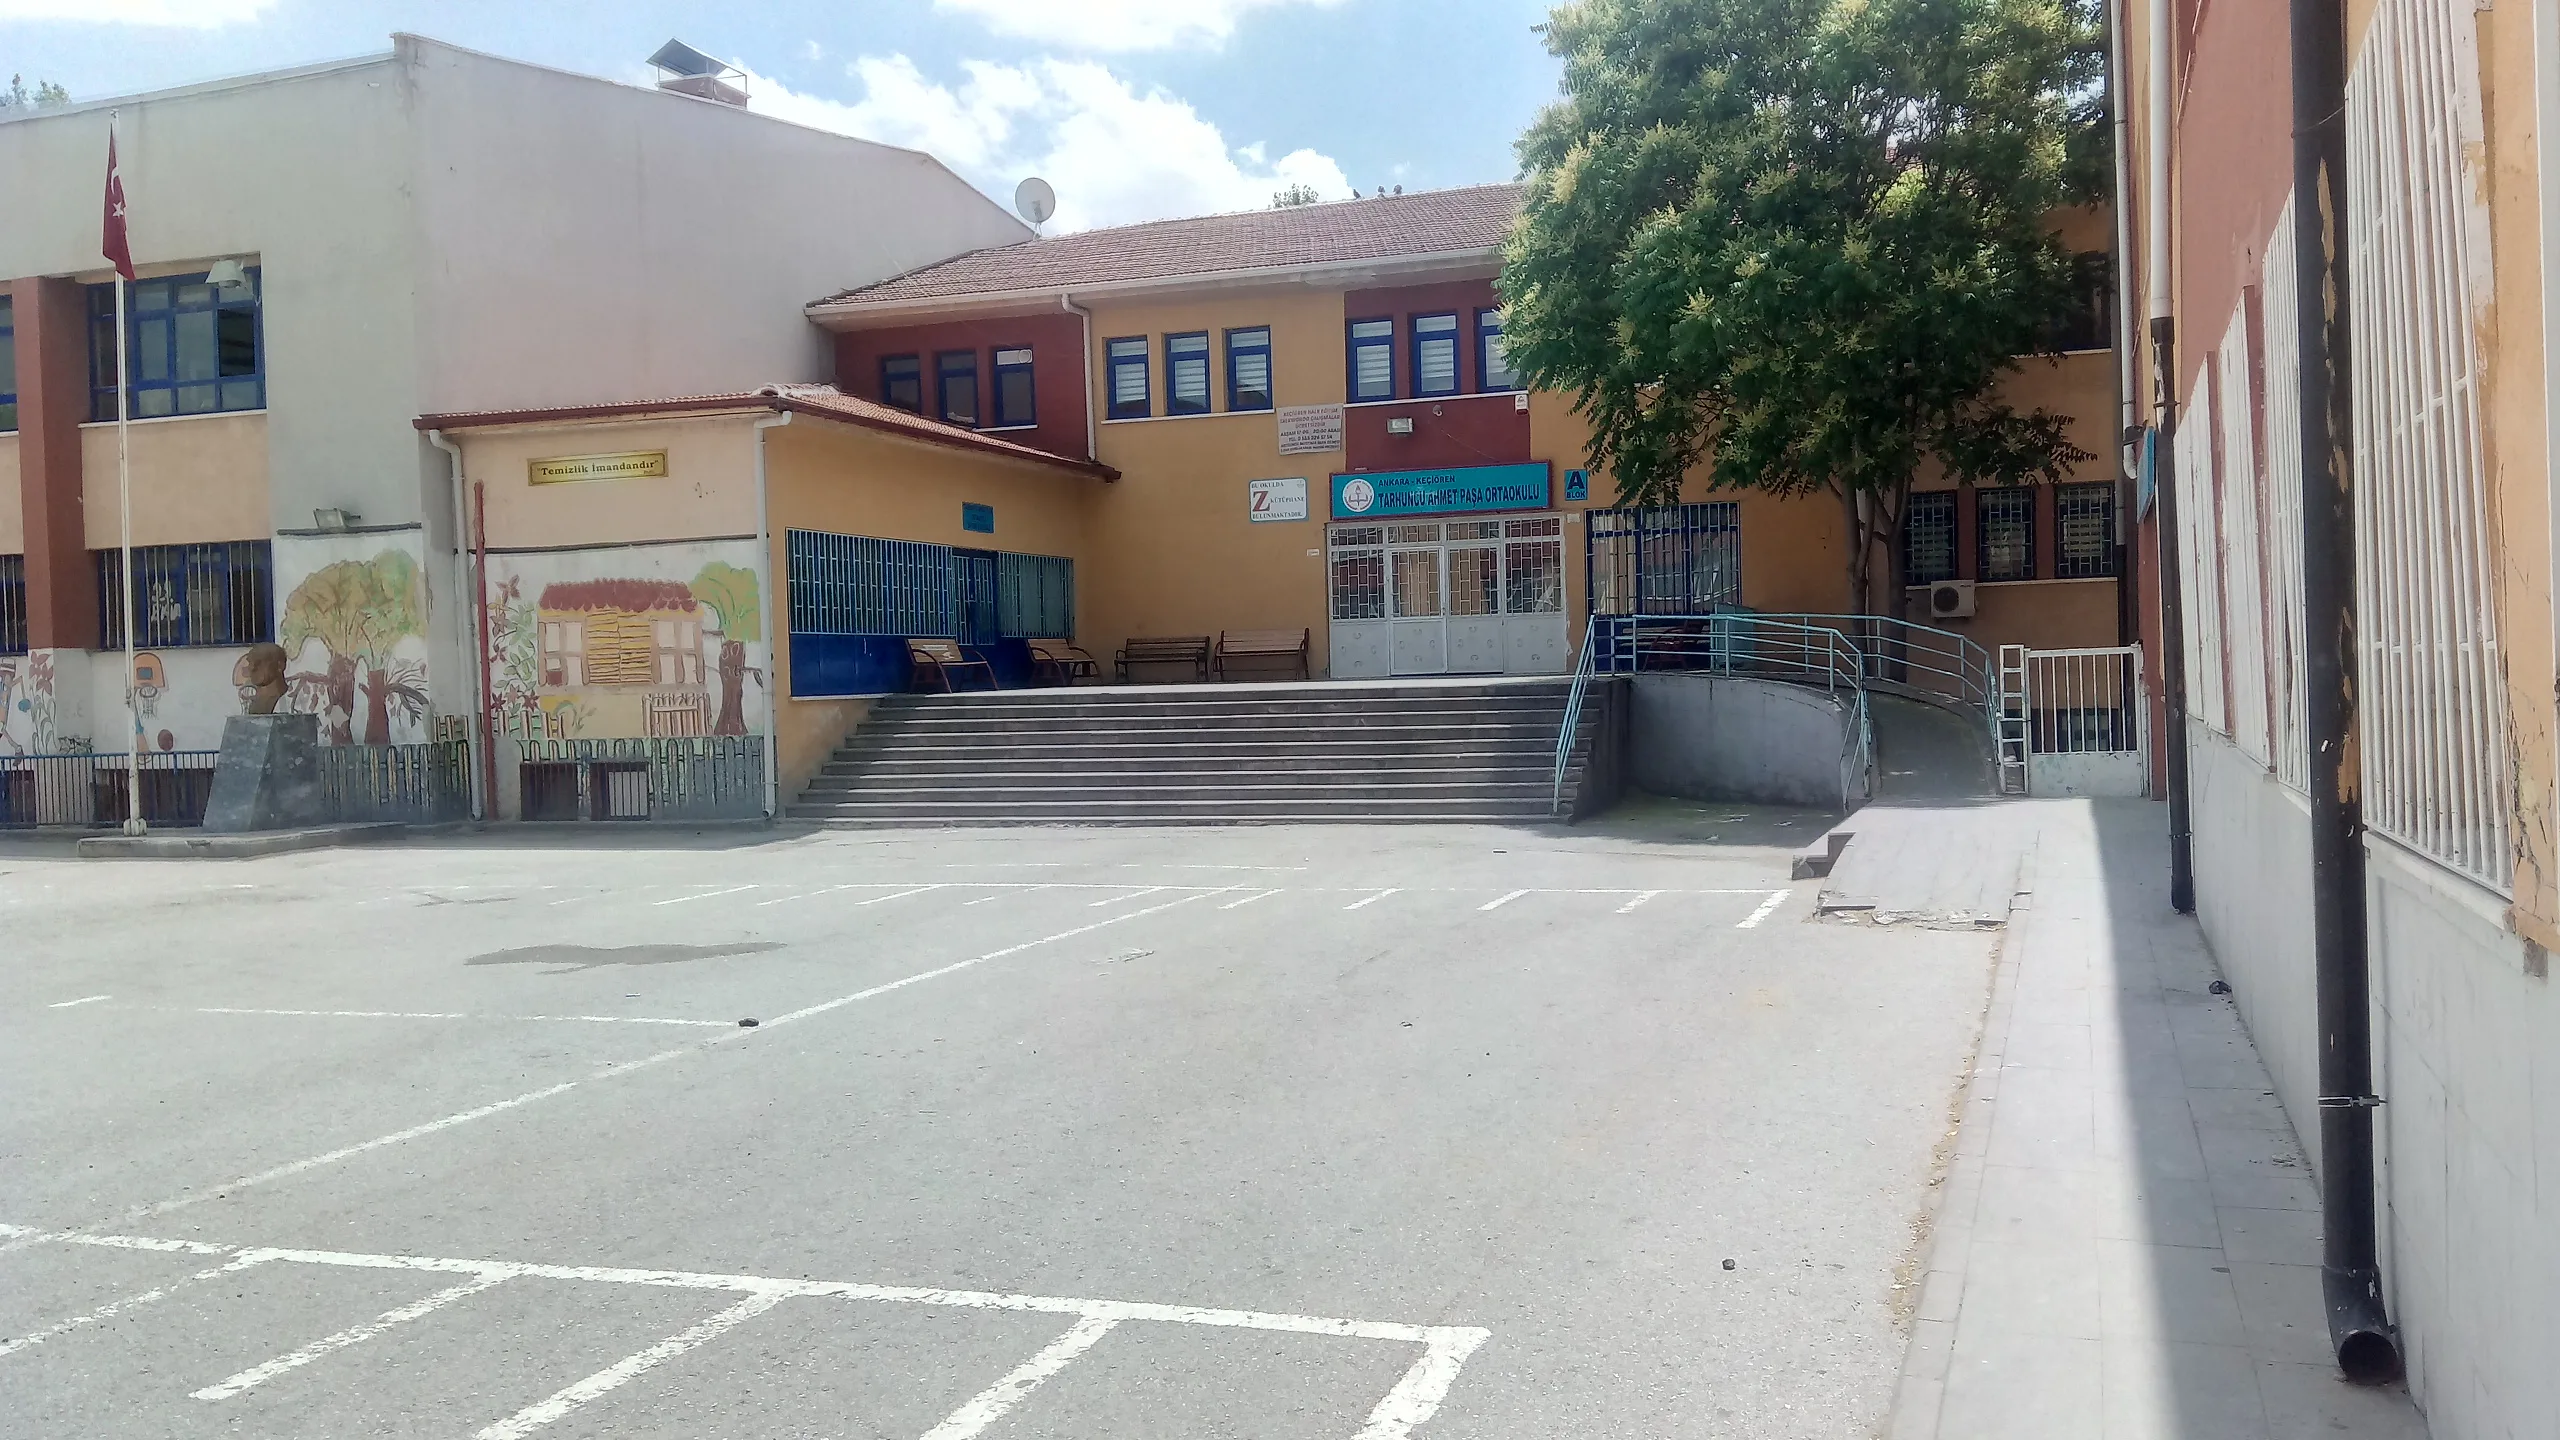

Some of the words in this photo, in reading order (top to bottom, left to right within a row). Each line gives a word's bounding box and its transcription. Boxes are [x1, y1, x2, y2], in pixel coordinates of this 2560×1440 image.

[1379, 477, 1410, 488] ANKARA
[1416, 474, 1456, 486] KEÇİÖREN
[1567, 471, 1585, 489] A
[1252, 491, 1271, 512] Z
[1379, 490, 1426, 508] TARHUNCU
[1427, 487, 1458, 505] AHMET
[1460, 487, 1482, 507] PAŞA
[1484, 483, 1540, 502] ORTAOKULU
[1566, 490, 1586, 499] BLOK
